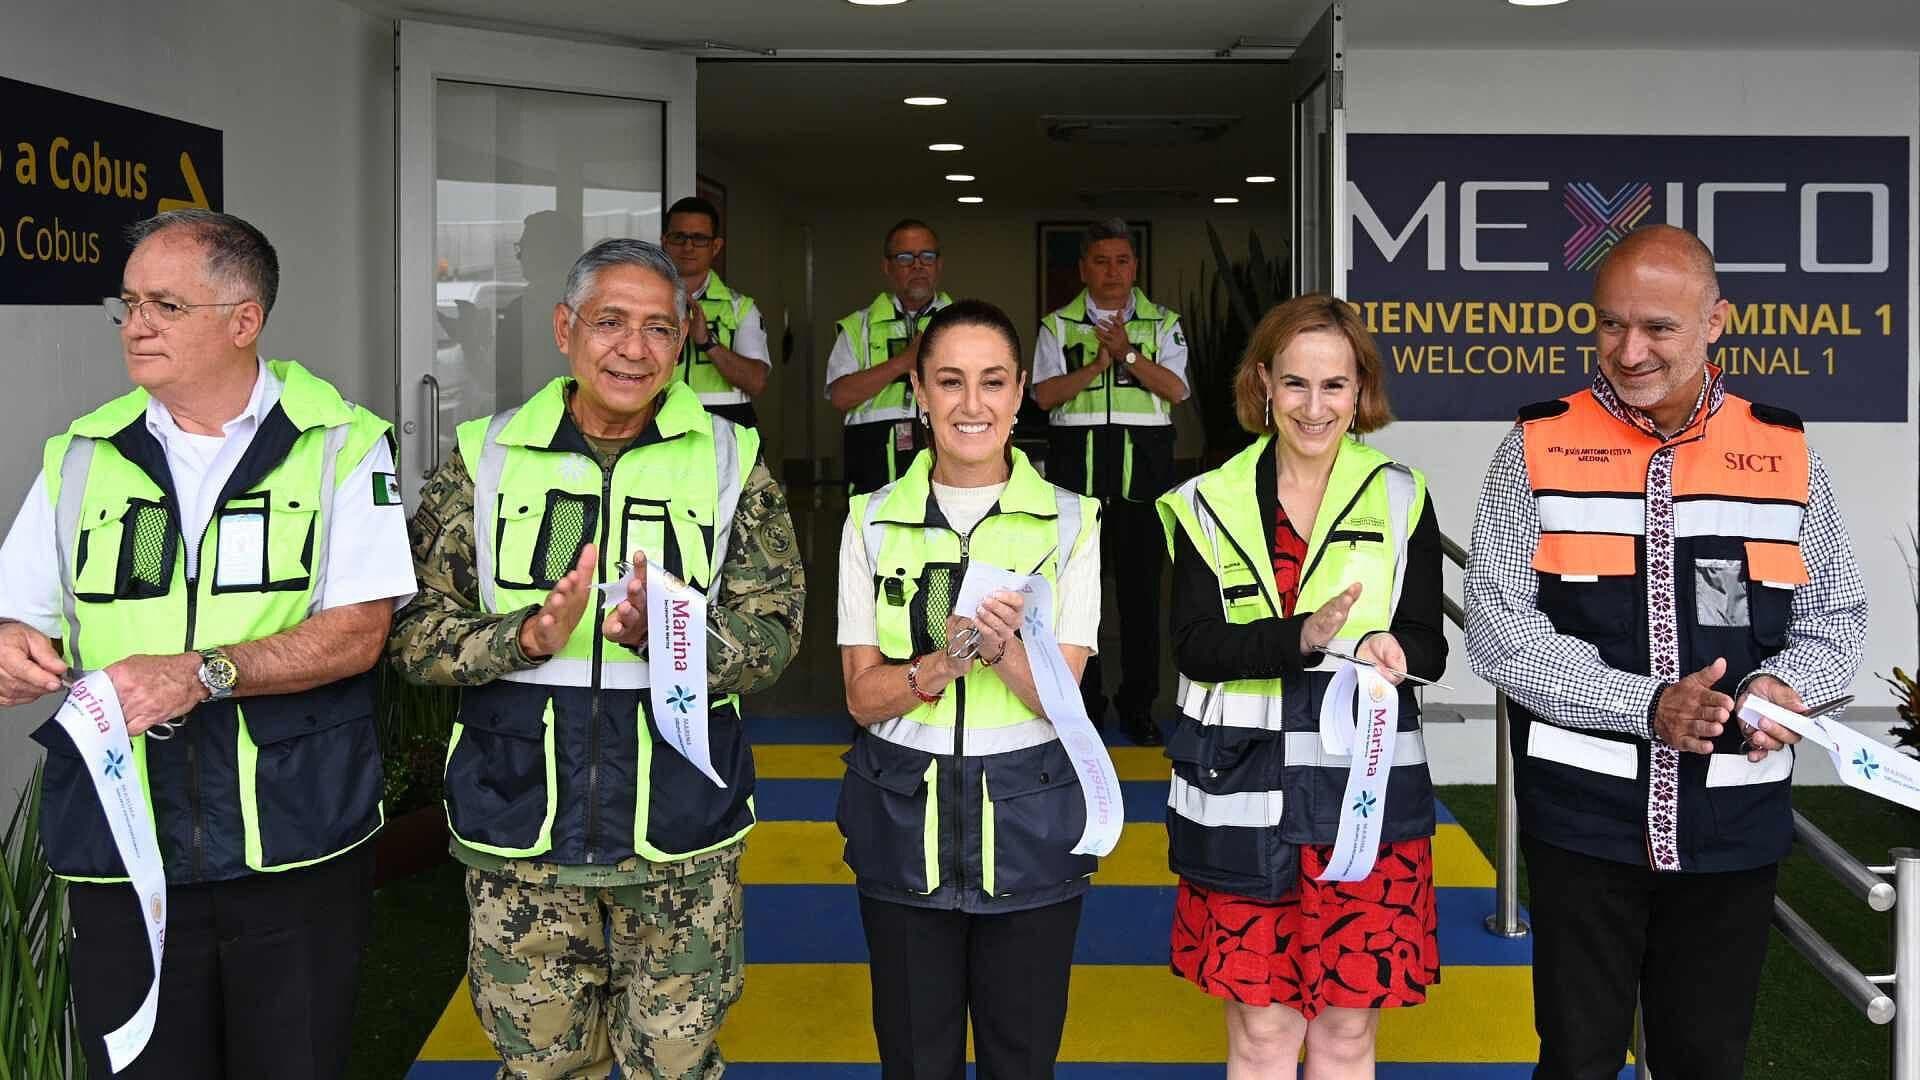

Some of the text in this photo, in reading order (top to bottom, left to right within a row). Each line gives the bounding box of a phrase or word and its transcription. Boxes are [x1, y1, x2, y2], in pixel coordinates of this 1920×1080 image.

[15, 141, 37, 185] a
[50, 136, 149, 201] Cobus
[16, 215, 101, 264] Cobus
[1347, 180, 1890, 273] MEXICO
[1349, 301, 1893, 336] IENVENIDO MINAL 1
[1391, 345, 1837, 375] WELCOME T INAL 1
[1724, 451, 1782, 473] SICT
[672, 599, 691, 672] Marina
[1366, 708, 1387, 777] Marina
